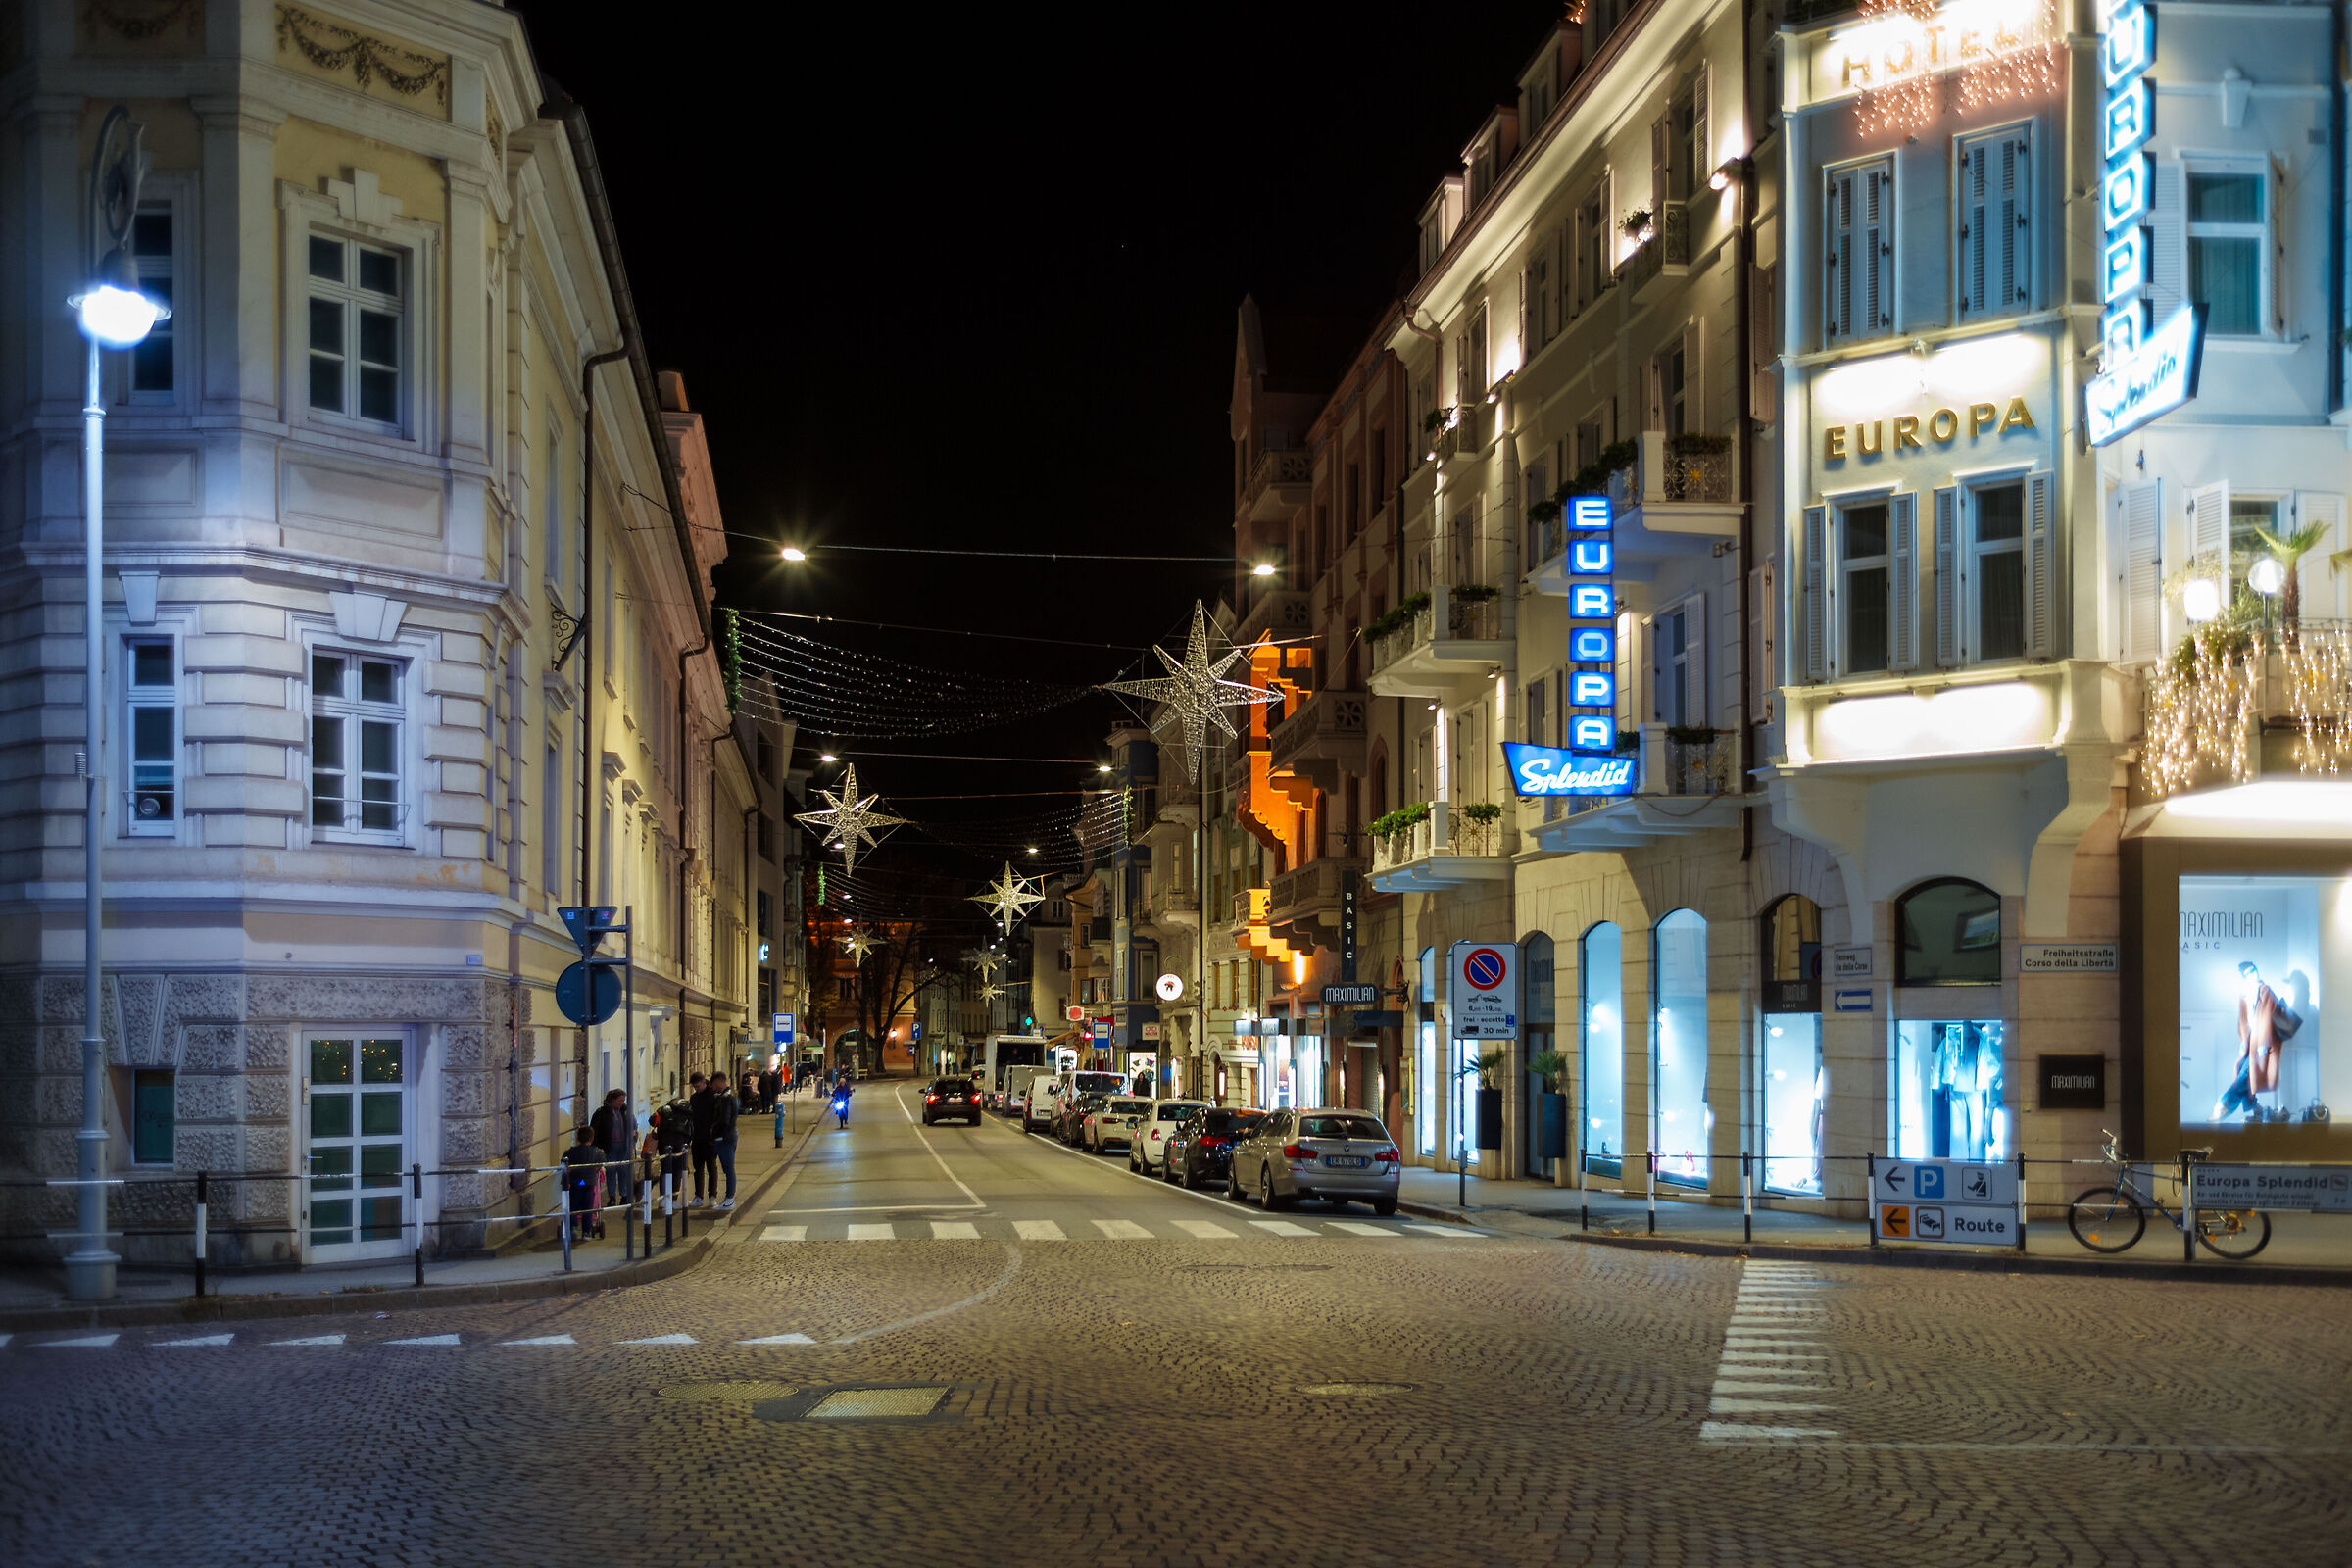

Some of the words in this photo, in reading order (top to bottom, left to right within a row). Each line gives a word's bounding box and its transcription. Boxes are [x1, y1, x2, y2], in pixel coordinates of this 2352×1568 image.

[1824, 395, 2036, 461] EUROPA
[1574, 499, 1610, 747] EUROPA
[1520, 756, 1631, 795] Splendid
[2043, 949, 2114, 957] Freiheitsstraße
[2182, 941, 2220, 950] ASIC
[2081, 958, 2114, 967] Libertà
[1326, 987, 1375, 1002] MAXIMILIAN
[2051, 1075, 2095, 1089] MAXIMILIAN
[1920, 1169, 1938, 1195] P
[2196, 1175, 2250, 1189] Europa
[2257, 1176, 2328, 1189] Splendid
[1954, 1217, 2005, 1233] Route
